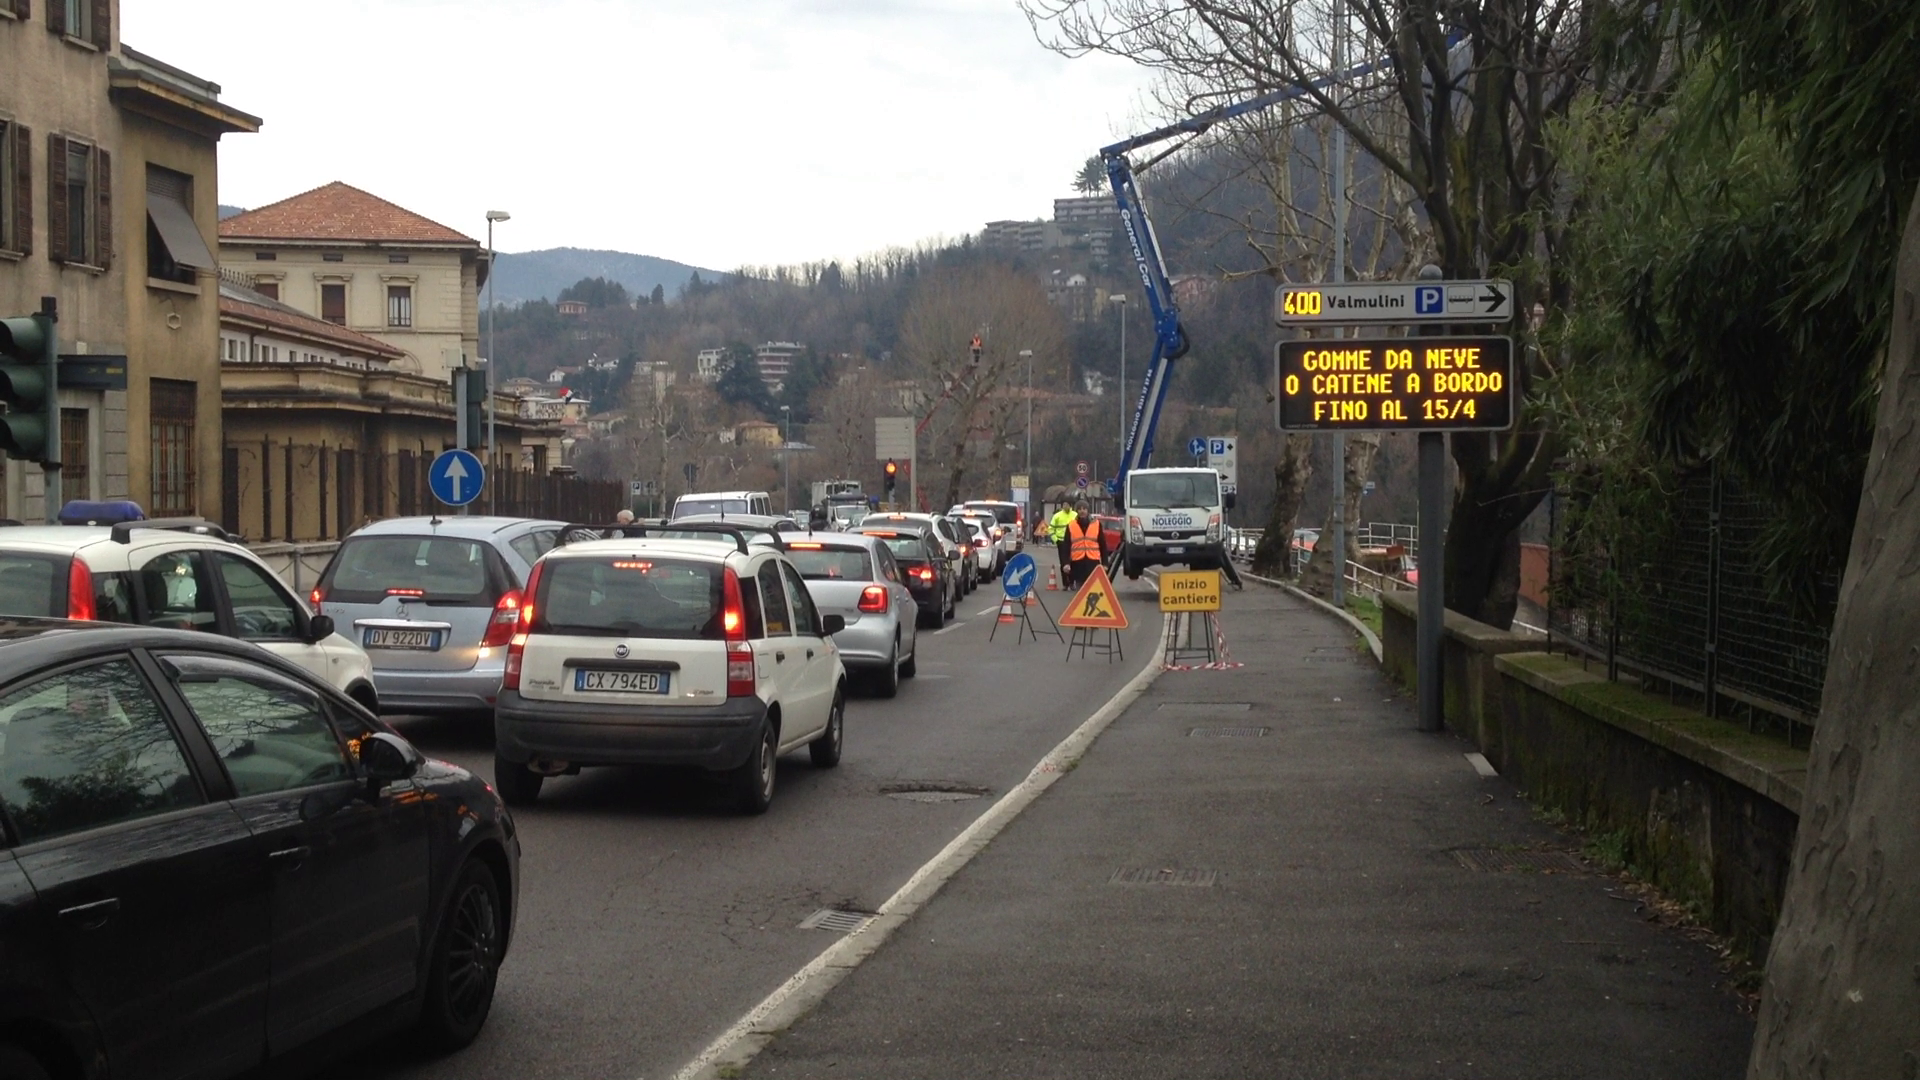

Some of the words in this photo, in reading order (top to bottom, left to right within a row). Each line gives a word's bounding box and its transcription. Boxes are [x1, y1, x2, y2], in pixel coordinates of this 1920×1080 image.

[1121, 208, 1145, 261] General
[1139, 263, 1152, 289] Car
[1284, 291, 1321, 315] 400
[1327, 294, 1404, 308] Valmulini
[1421, 288, 1440, 313] P
[1303, 350, 1372, 371] GOMME
[1385, 349, 1412, 370] DA
[1426, 348, 1481, 369] NEVE
[1285, 375, 1299, 395] O
[1312, 373, 1393, 394] CATENE
[1406, 373, 1420, 393] A
[1434, 372, 1502, 393] BORDO
[1314, 400, 1367, 421] FINO
[1381, 400, 1408, 420] AL
[1422, 399, 1476, 419] 15/4
[1152, 517, 1192, 526] NOLEGGIO
[1172, 578, 1207, 589] inizio
[1162, 593, 1217, 605] cantiere
[372, 630, 388, 645] DV
[393, 631, 431, 646] 922DV
[586, 672, 605, 688] CX
[610, 673, 659, 690] 794ED
